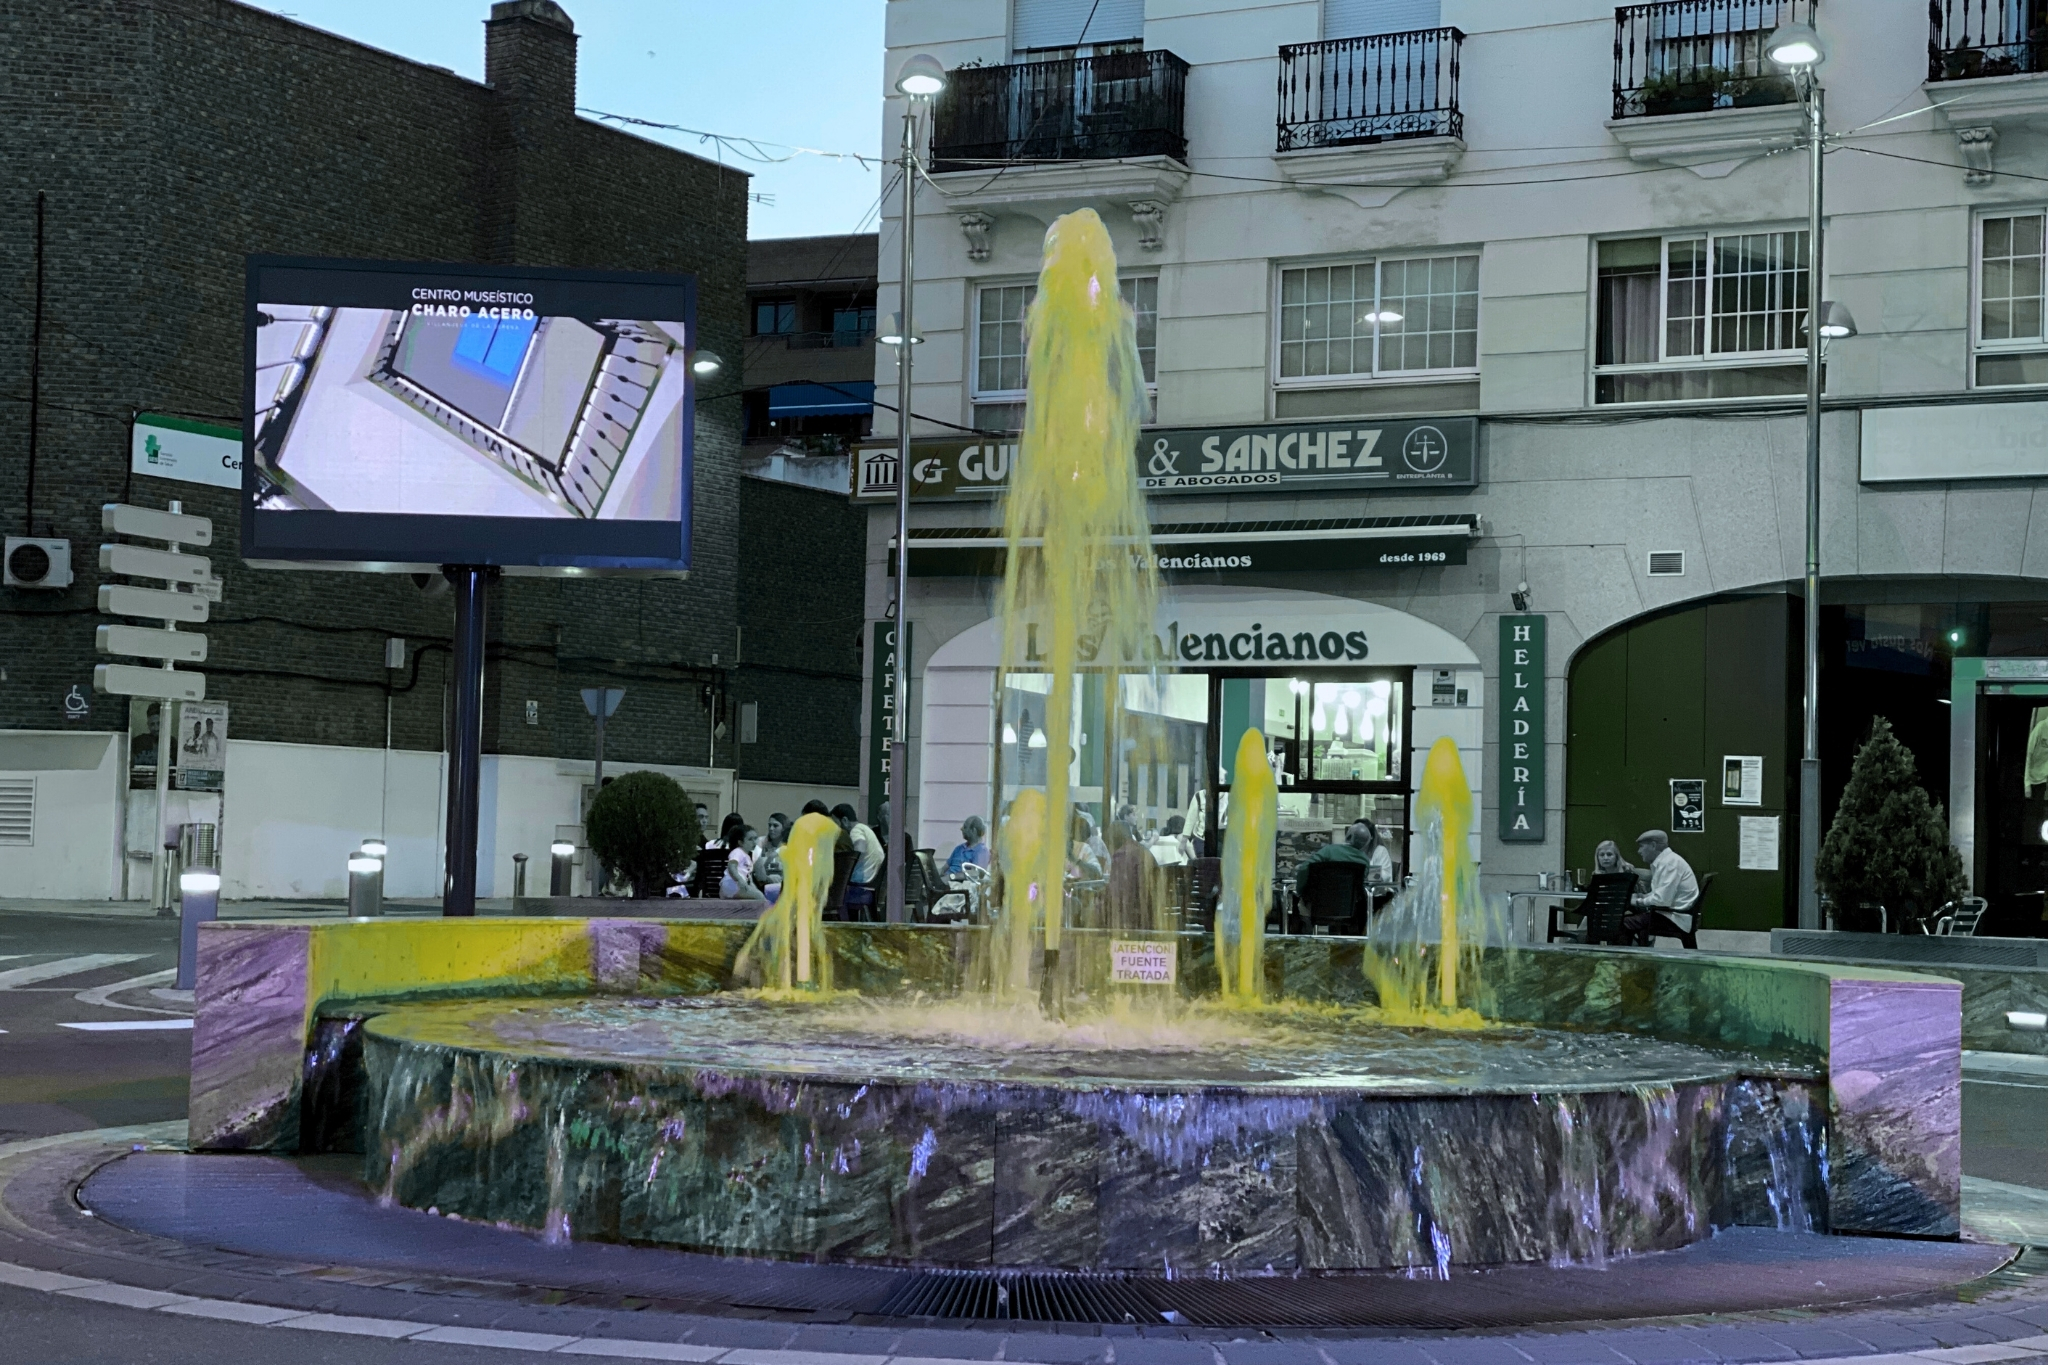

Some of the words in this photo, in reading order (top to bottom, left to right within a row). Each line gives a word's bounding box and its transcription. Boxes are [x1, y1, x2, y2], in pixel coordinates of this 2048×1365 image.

[412, 288, 461, 301] CENTRO
[464, 289, 533, 304] MUSEÍSTICO
[411, 303, 470, 318] CHARO
[478, 306, 534, 320] ACERO
[1148, 438, 1179, 475] &
[1201, 429, 1383, 473] SANCHEZ
[1145, 477, 1167, 487] DE
[1174, 473, 1278, 487] ABOGADOS
[1130, 553, 1252, 569] Valencianos
[1379, 552, 1415, 563] desde
[1418, 551, 1446, 562] 1969
[1025, 622, 1098, 662] Ls
[1513, 625, 1531, 831] HELADERÍA
[1121, 956, 1167, 967] FUENTE
[1116, 969, 1170, 980] TRATADA
